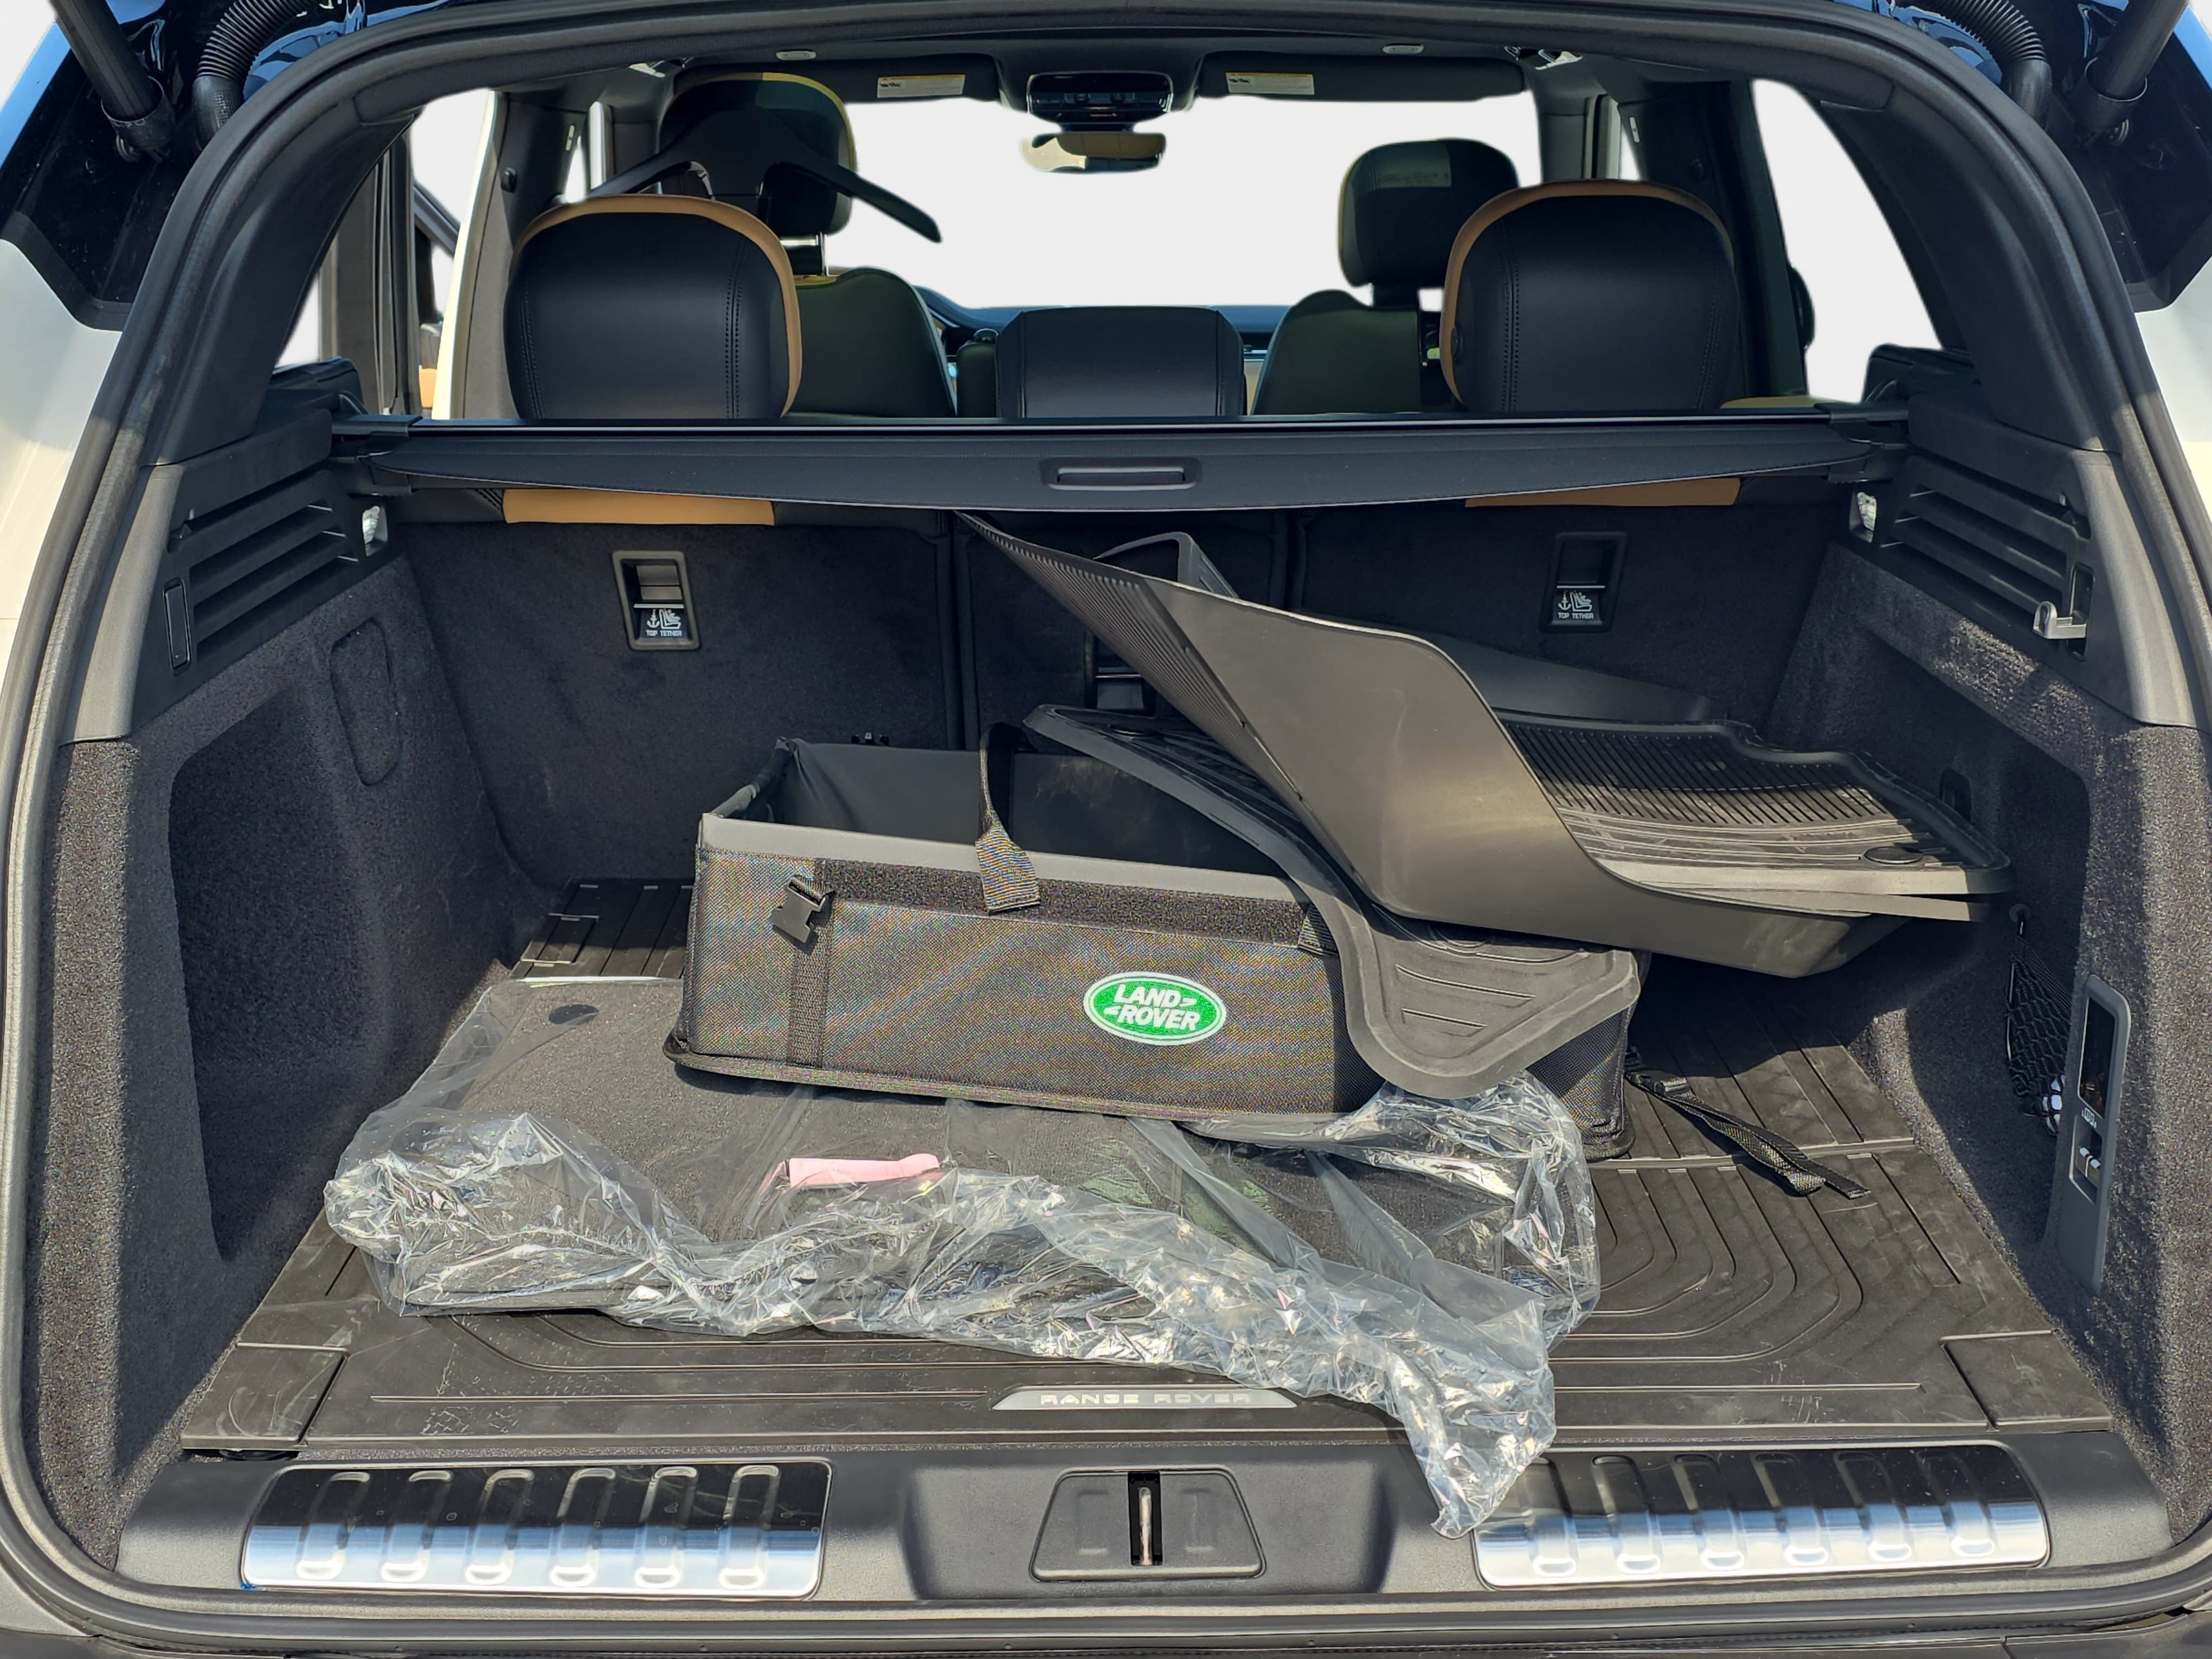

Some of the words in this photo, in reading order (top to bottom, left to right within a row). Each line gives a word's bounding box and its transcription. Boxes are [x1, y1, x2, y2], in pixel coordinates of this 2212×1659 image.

[1114, 984, 1181, 1008] LAND
[1117, 1005, 1200, 1031] ROVER
[1040, 1394, 1140, 1405] RANGE
[1153, 1393, 1251, 1404] ROVER
